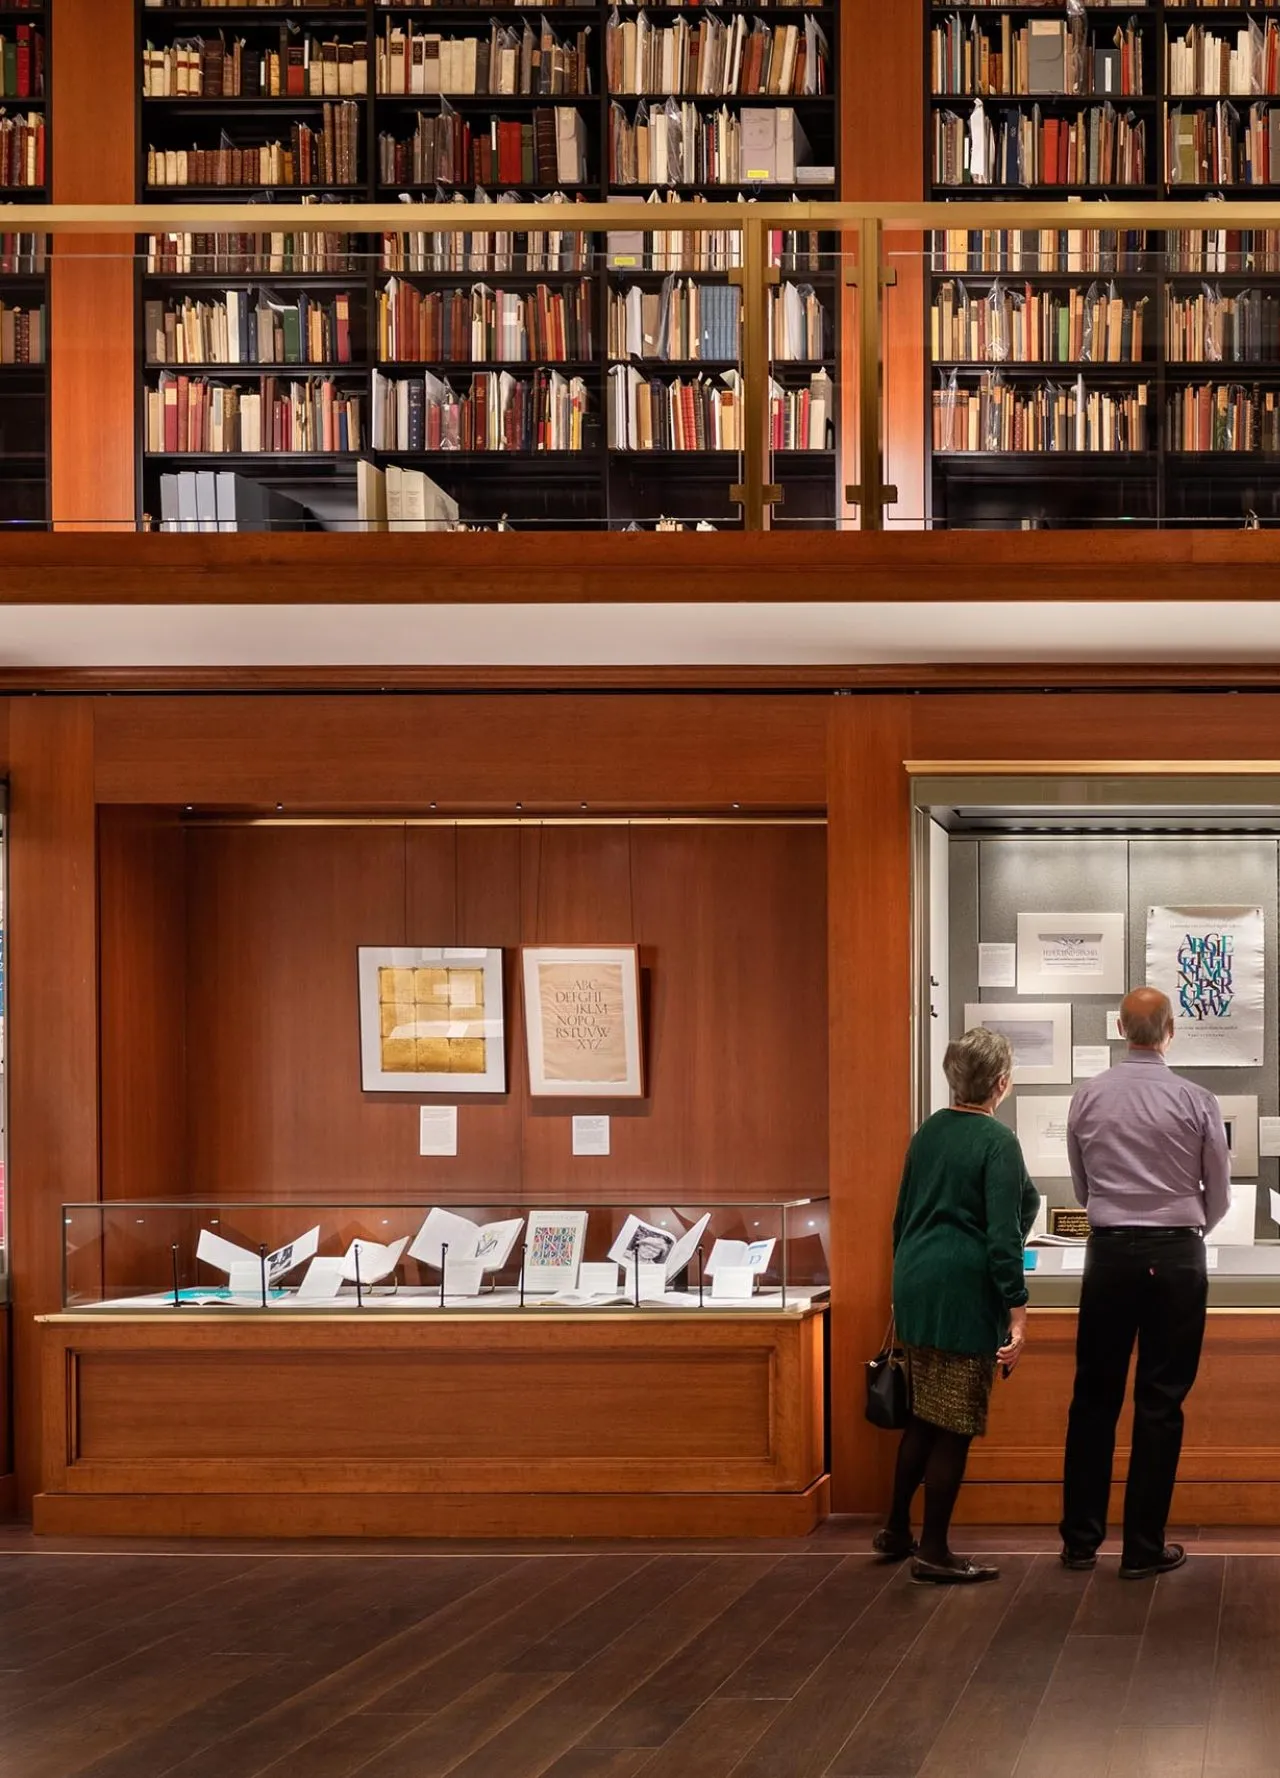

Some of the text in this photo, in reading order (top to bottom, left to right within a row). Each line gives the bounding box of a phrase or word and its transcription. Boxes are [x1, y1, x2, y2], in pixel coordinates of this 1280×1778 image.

[572, 979, 598, 990] ABC
[556, 991, 602, 1003] DEFGHI
[576, 1003, 608, 1014] JKLM
[556, 1027, 611, 1038] RSTUVW
[576, 1038, 603, 1050] XYZ
